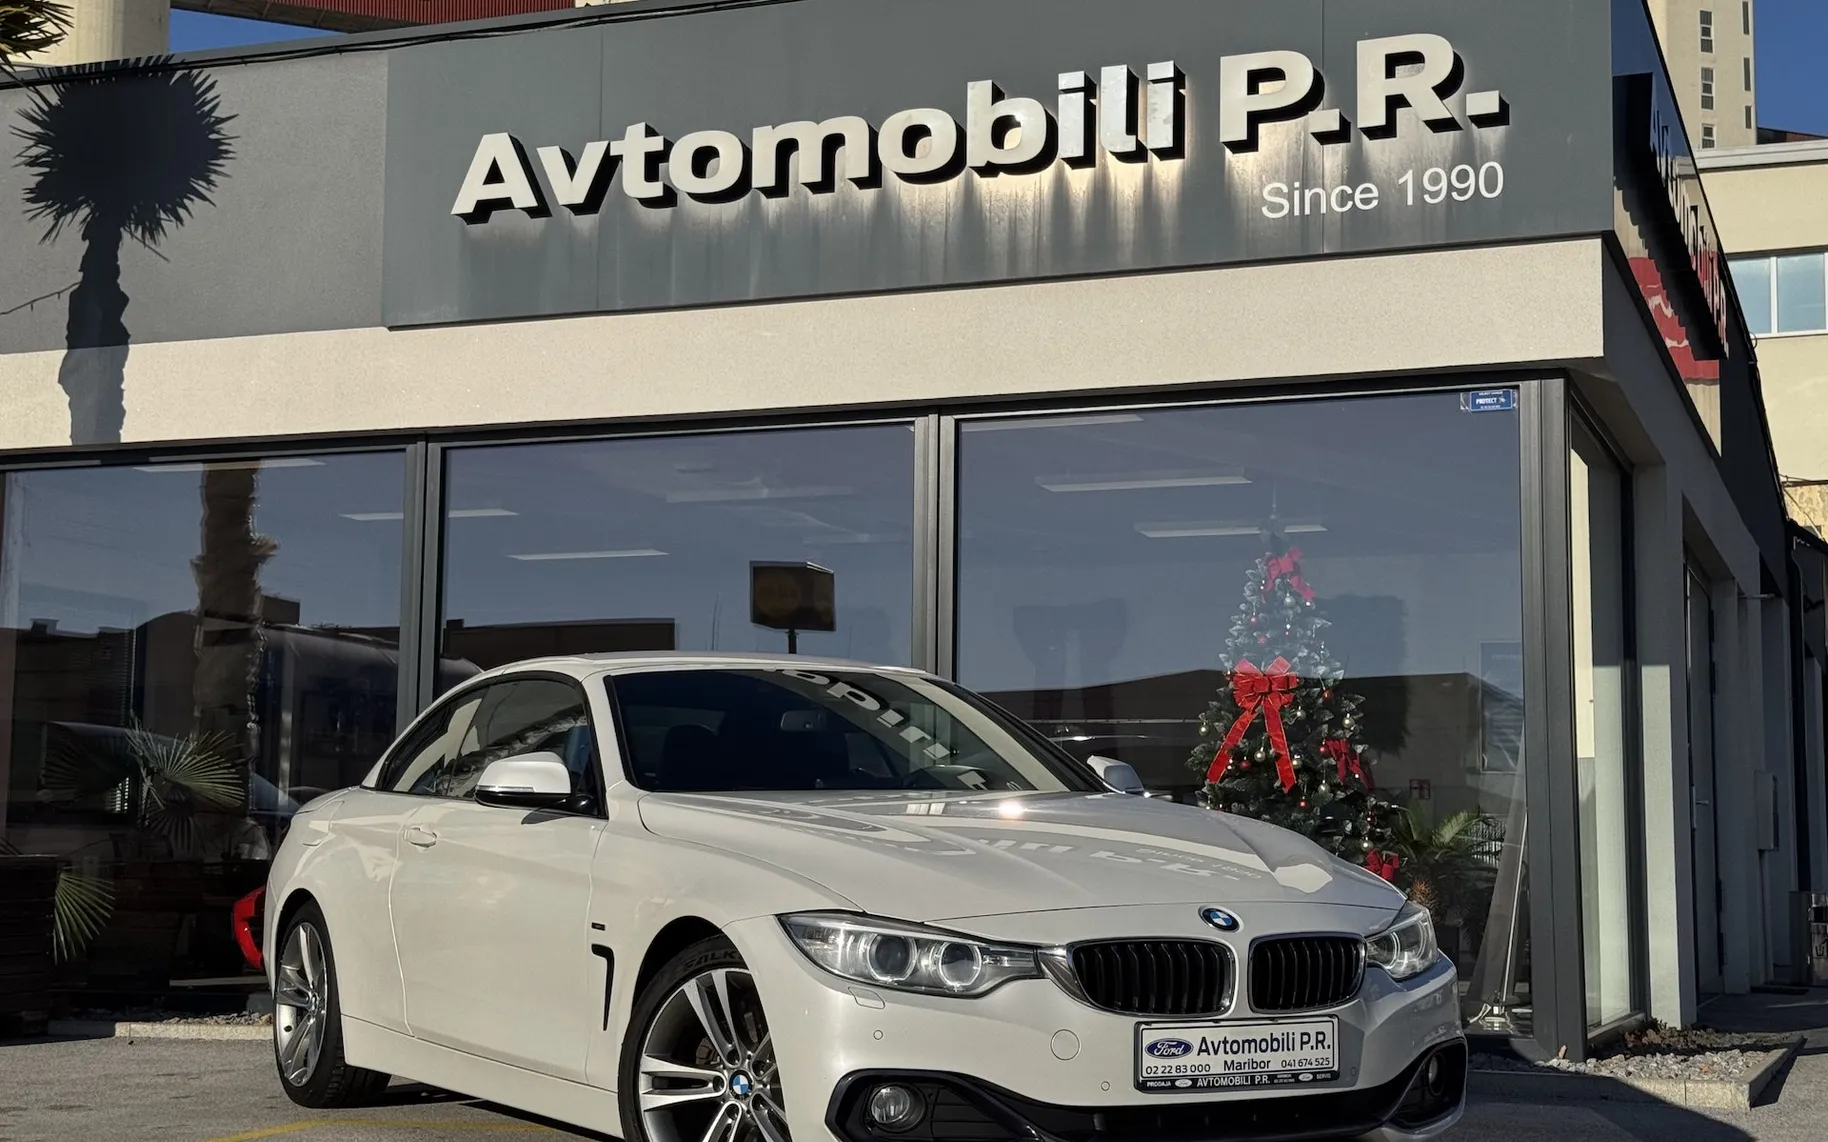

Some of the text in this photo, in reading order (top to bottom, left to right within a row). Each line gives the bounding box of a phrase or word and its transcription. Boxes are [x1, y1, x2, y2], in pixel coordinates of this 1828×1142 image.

[450, 33, 1506, 222] Avtomobili P.R.
[1261, 161, 1504, 219] Since 1990
[1153, 1041, 1185, 1056] Ford
[1197, 1031, 1331, 1056] Avtomobili P.R.
[1145, 1063, 1211, 1075] 02 22 83 000
[1223, 1058, 1271, 1072] Maribor
[1281, 1057, 1330, 1069] 041 674 525
[1197, 1075, 1251, 1088] AVTOMOBILI
[1254, 1075, 1271, 1085] P.R.
